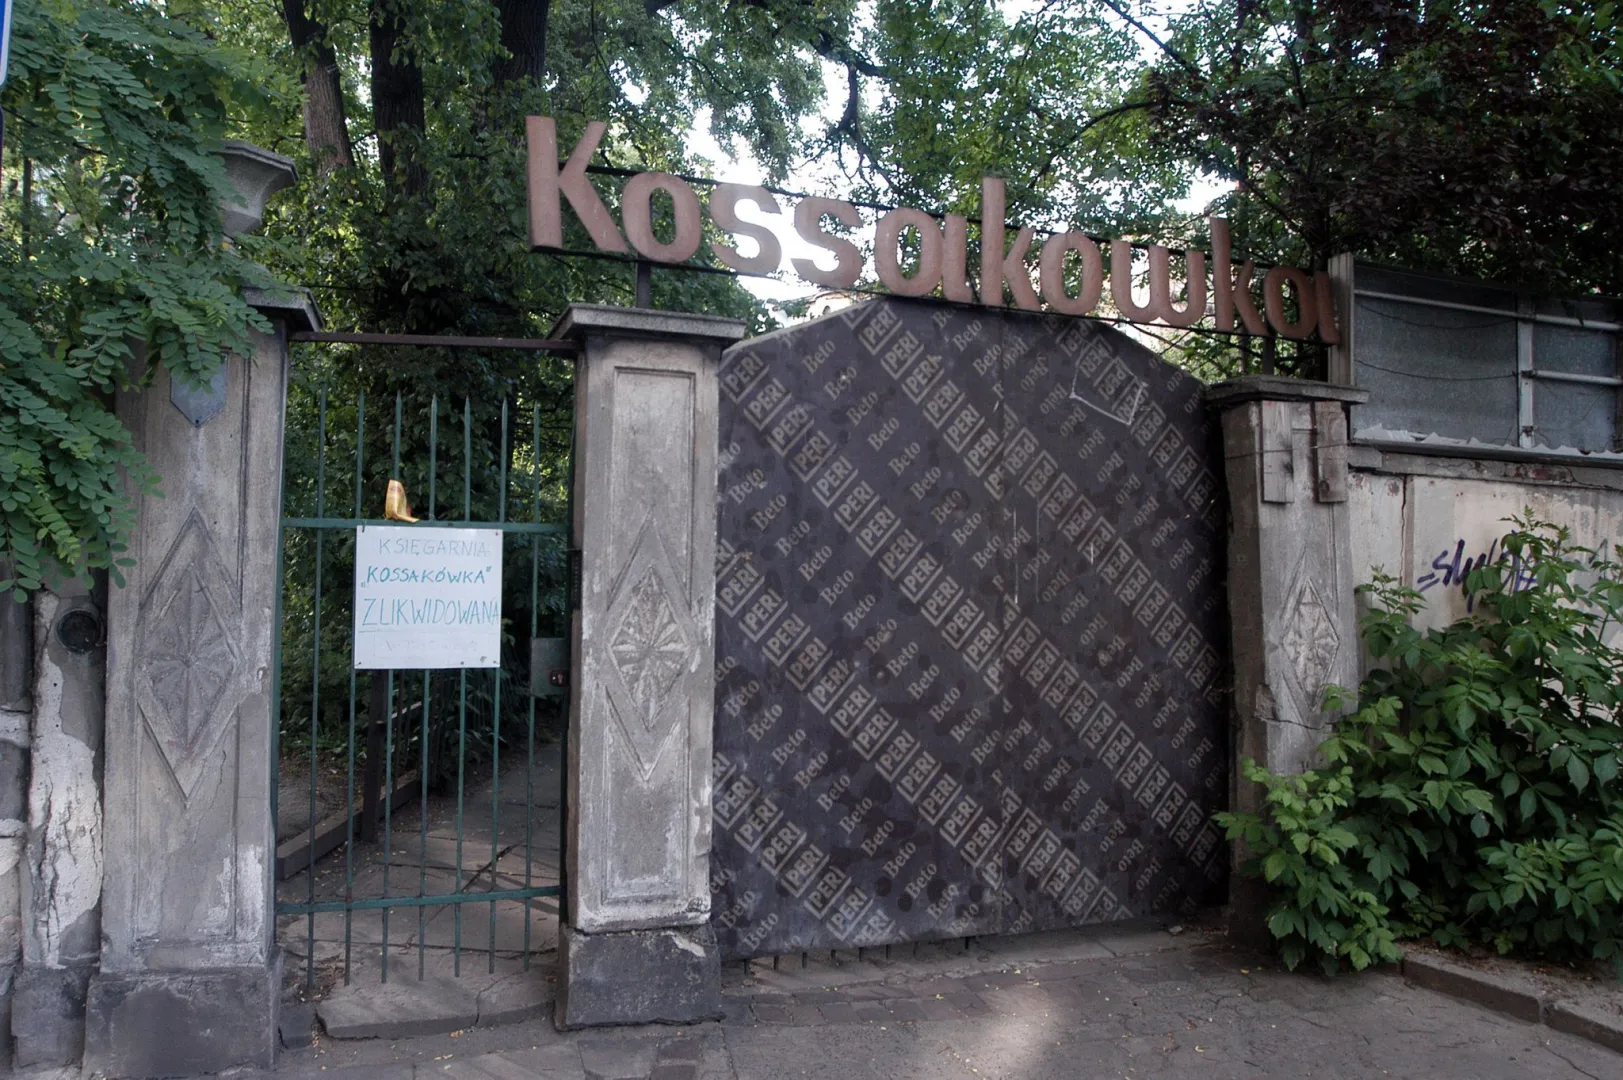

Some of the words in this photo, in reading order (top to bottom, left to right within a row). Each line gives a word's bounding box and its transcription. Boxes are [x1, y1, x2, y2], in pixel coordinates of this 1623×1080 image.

[864, 307, 897, 344] PERI
[952, 320, 982, 351] Beto
[802, 339, 836, 374] Beto
[887, 331, 918, 368] PERI
[972, 343, 1001, 376] Beto
[725, 352, 763, 391] PERI
[1100, 365, 1126, 400] PERI
[750, 378, 786, 418] PERI
[847, 391, 879, 426] Beto
[929, 380, 959, 418] PERI
[1040, 383, 1069, 414] Beto
[773, 406, 809, 445] PERI
[867, 417, 899, 450] Beto
[949, 405, 980, 440] PERI
[1060, 406, 1086, 437] Beto
[1132, 409, 1163, 445] PERI
[794, 431, 831, 471] PERI
[888, 442, 920, 476] Beto
[969, 428, 999, 466] PERI
[1006, 435, 1035, 474] PERI
[1079, 429, 1105, 460] Beto
[1153, 432, 1179, 468] PERI
[818, 456, 852, 496] PERI
[910, 467, 942, 500] Beto
[1024, 458, 1055, 497] PERI
[1098, 453, 1124, 481] Beto
[1172, 455, 1198, 489] PERI
[728, 469, 765, 504] Beto
[840, 481, 874, 522] PERI
[1044, 483, 1074, 520] PERI
[1116, 474, 1141, 504] Beto
[752, 494, 786, 531] Beto
[931, 490, 961, 524] Beto
[1063, 504, 1093, 542] PERI
[1134, 496, 1159, 526] Beto
[775, 520, 810, 556] Beto
[862, 506, 895, 546] PERI
[952, 512, 982, 547] Beto
[1152, 518, 1177, 548] Beto
[379, 538, 488, 557] KSIĘGARNIA
[798, 546, 832, 581] Beto
[883, 530, 917, 568] PERI
[972, 535, 1000, 569] Beto
[1023, 549, 1050, 581] Beto
[1101, 546, 1130, 584] PERI
[1170, 540, 1194, 570] Beto
[720, 564, 759, 606] PERI
[820, 570, 854, 606] Beto
[904, 553, 938, 592] PERI
[1042, 569, 1070, 601] Beto
[1119, 568, 1148, 606] PERI
[362, 598, 501, 626] ZLIKWIDOWANA
[744, 589, 782, 629] PERI
[842, 595, 876, 630] Beto
[925, 576, 959, 615] PERI
[1061, 592, 1089, 624] Beto
[1138, 589, 1167, 627] PERI
[767, 613, 804, 653] PERI
[948, 599, 978, 638] PERI
[1080, 612, 1108, 645] Beto
[1155, 610, 1182, 647] PERI
[791, 637, 827, 678] PERI
[886, 641, 919, 677] Beto
[968, 622, 999, 661] PERI
[1006, 624, 1035, 666] PERI
[1173, 632, 1199, 668] PERI
[908, 664, 940, 699] Beto
[1026, 645, 1056, 687] PERI
[1117, 656, 1144, 687] Beto
[836, 685, 871, 725] PERI
[928, 687, 960, 723] Beto
[1045, 667, 1075, 708] PERI
[1135, 674, 1161, 708] Beto
[748, 703, 783, 742] Beto
[857, 708, 892, 747] PERI
[949, 708, 981, 743] Beto
[1064, 689, 1093, 729] PERI
[1153, 696, 1179, 729] Beto
[771, 729, 806, 767] Beto
[971, 730, 1000, 764] Beto
[1005, 718, 1032, 752] Beto
[1084, 710, 1113, 749] PERI
[1172, 716, 1196, 749] Beto
[880, 730, 914, 770] PERI
[1024, 738, 1052, 771] Beto
[1103, 730, 1131, 769] PERI
[1188, 738, 1213, 769] Beto
[794, 752, 828, 789] Beto
[902, 752, 935, 791] PERI
[1043, 758, 1071, 792] Beto
[1121, 750, 1149, 790] PERI
[716, 775, 753, 818] PERI
[817, 775, 850, 812] Beto
[923, 773, 957, 814] PERI
[1063, 778, 1091, 812] Beto
[1139, 770, 1167, 809] PERI
[739, 798, 777, 841] PERI
[839, 797, 873, 834] Beto
[943, 796, 977, 837] PERI
[1081, 799, 1109, 832] Beto
[1156, 790, 1183, 828] PERI
[763, 822, 799, 863] PERI
[861, 820, 894, 856] Beto
[965, 817, 998, 856] PERI
[1007, 815, 1036, 857] PERI
[1100, 819, 1127, 852] Beto
[1175, 809, 1200, 848] PERI
[786, 844, 823, 886] PERI
[883, 842, 916, 879] Beto
[1027, 836, 1056, 878] PERI
[1118, 838, 1144, 871] Beto
[809, 866, 845, 908] PERI
[905, 863, 937, 899] Beto
[1046, 856, 1077, 899] PERI
[1136, 857, 1163, 890] Beto
[720, 890, 755, 928] Beto
[831, 888, 866, 929] PERI
[927, 885, 959, 920] Beto
[1066, 876, 1096, 916] PERI
